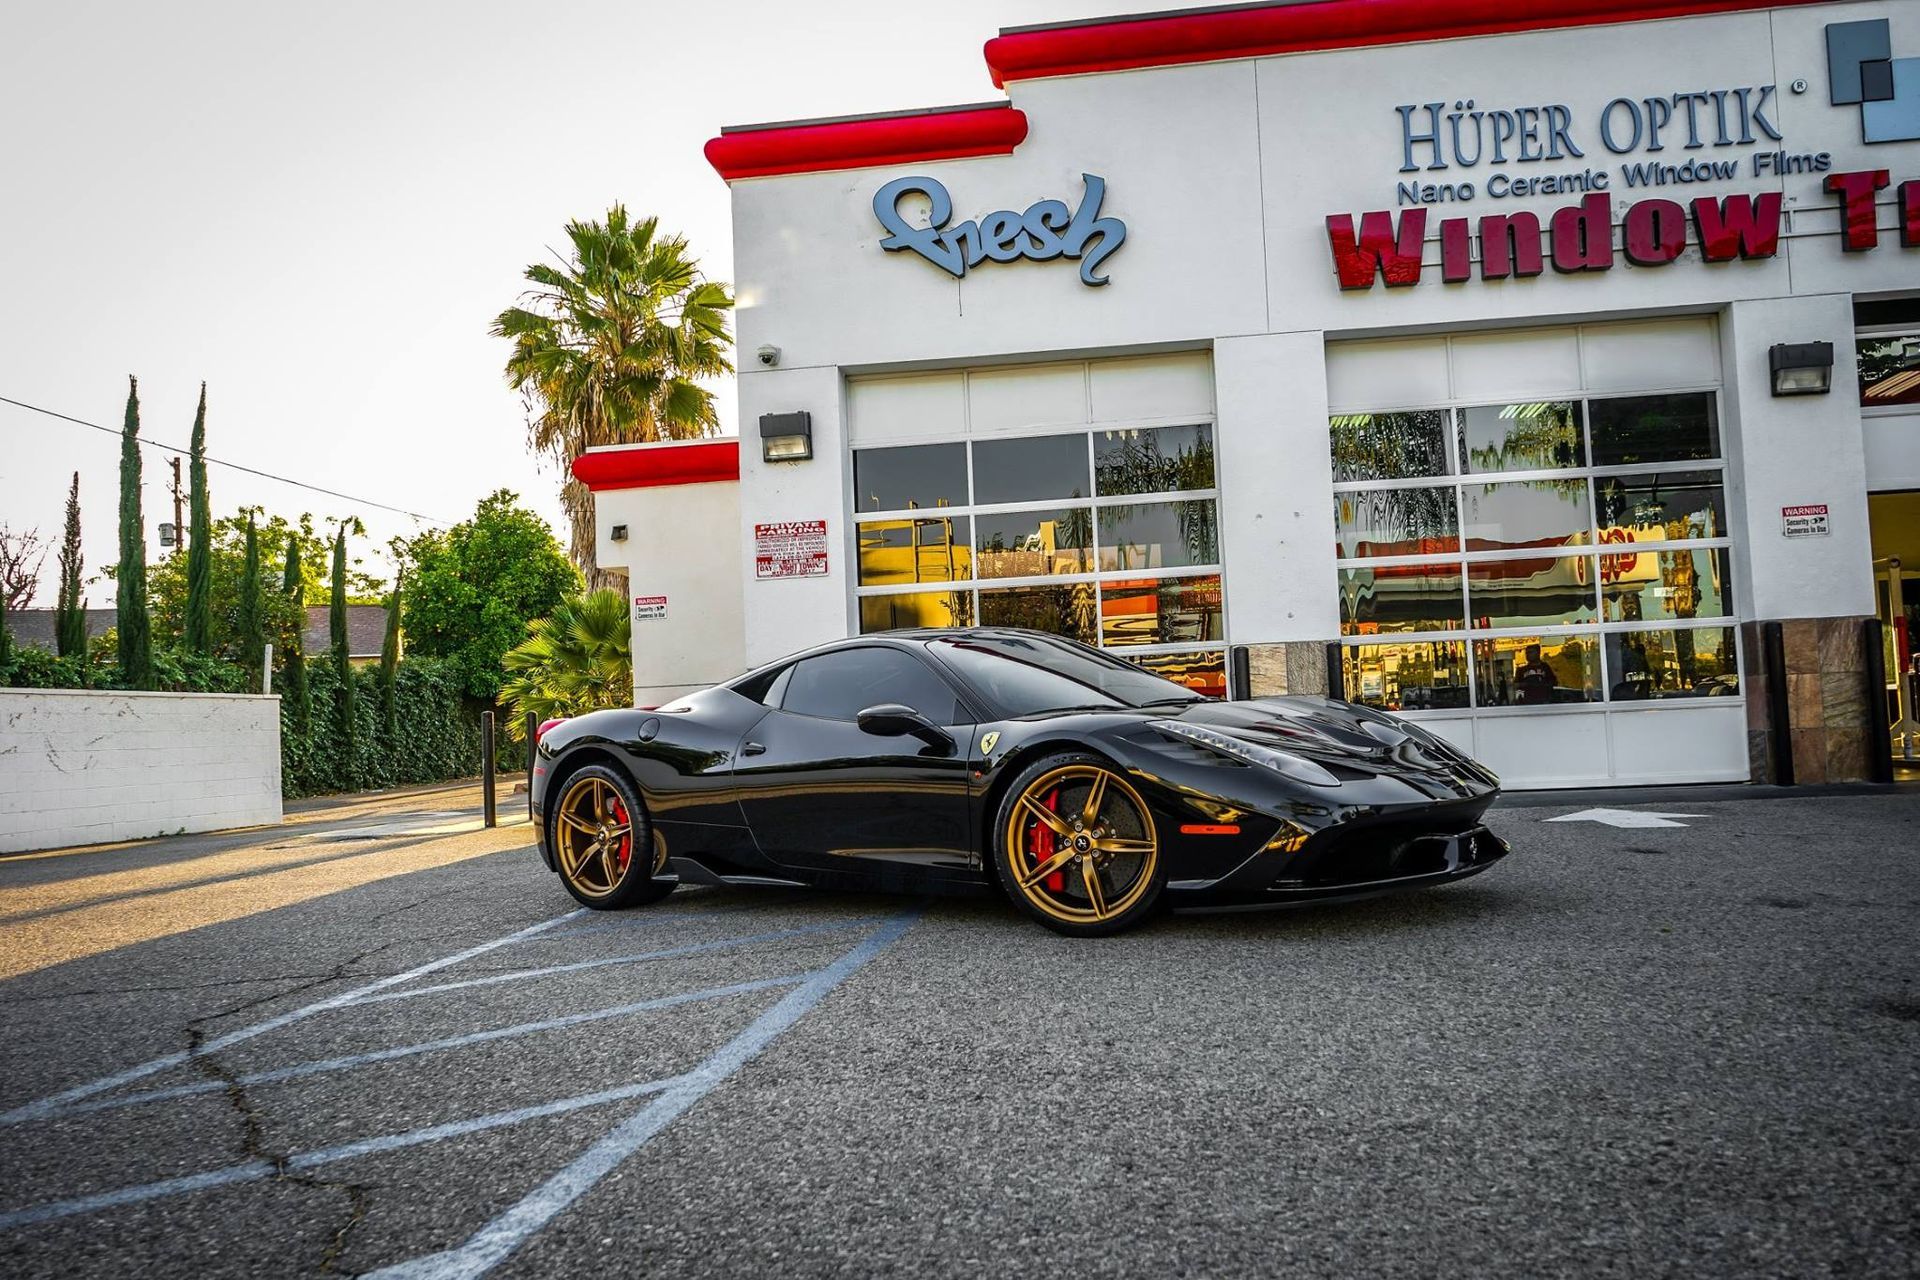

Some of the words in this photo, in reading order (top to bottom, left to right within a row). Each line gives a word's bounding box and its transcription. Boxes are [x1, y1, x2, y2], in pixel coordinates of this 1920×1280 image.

[1395, 99, 1585, 172] HÜPER
[1600, 84, 1783, 154] OPTIK
[1397, 180, 1475, 207] Nano
[1487, 168, 1609, 198] Ceramic
[1622, 157, 1738, 188] Window
[1753, 150, 1832, 178] Films
[1326, 192, 1783, 291] Window
[1784, 506, 1826, 516] WARNING
[760, 522, 820, 531] PRIVATE
[1786, 518, 1809, 526] Security
[757, 527, 826, 536] PARKING
[637, 597, 665, 605] WARNING
